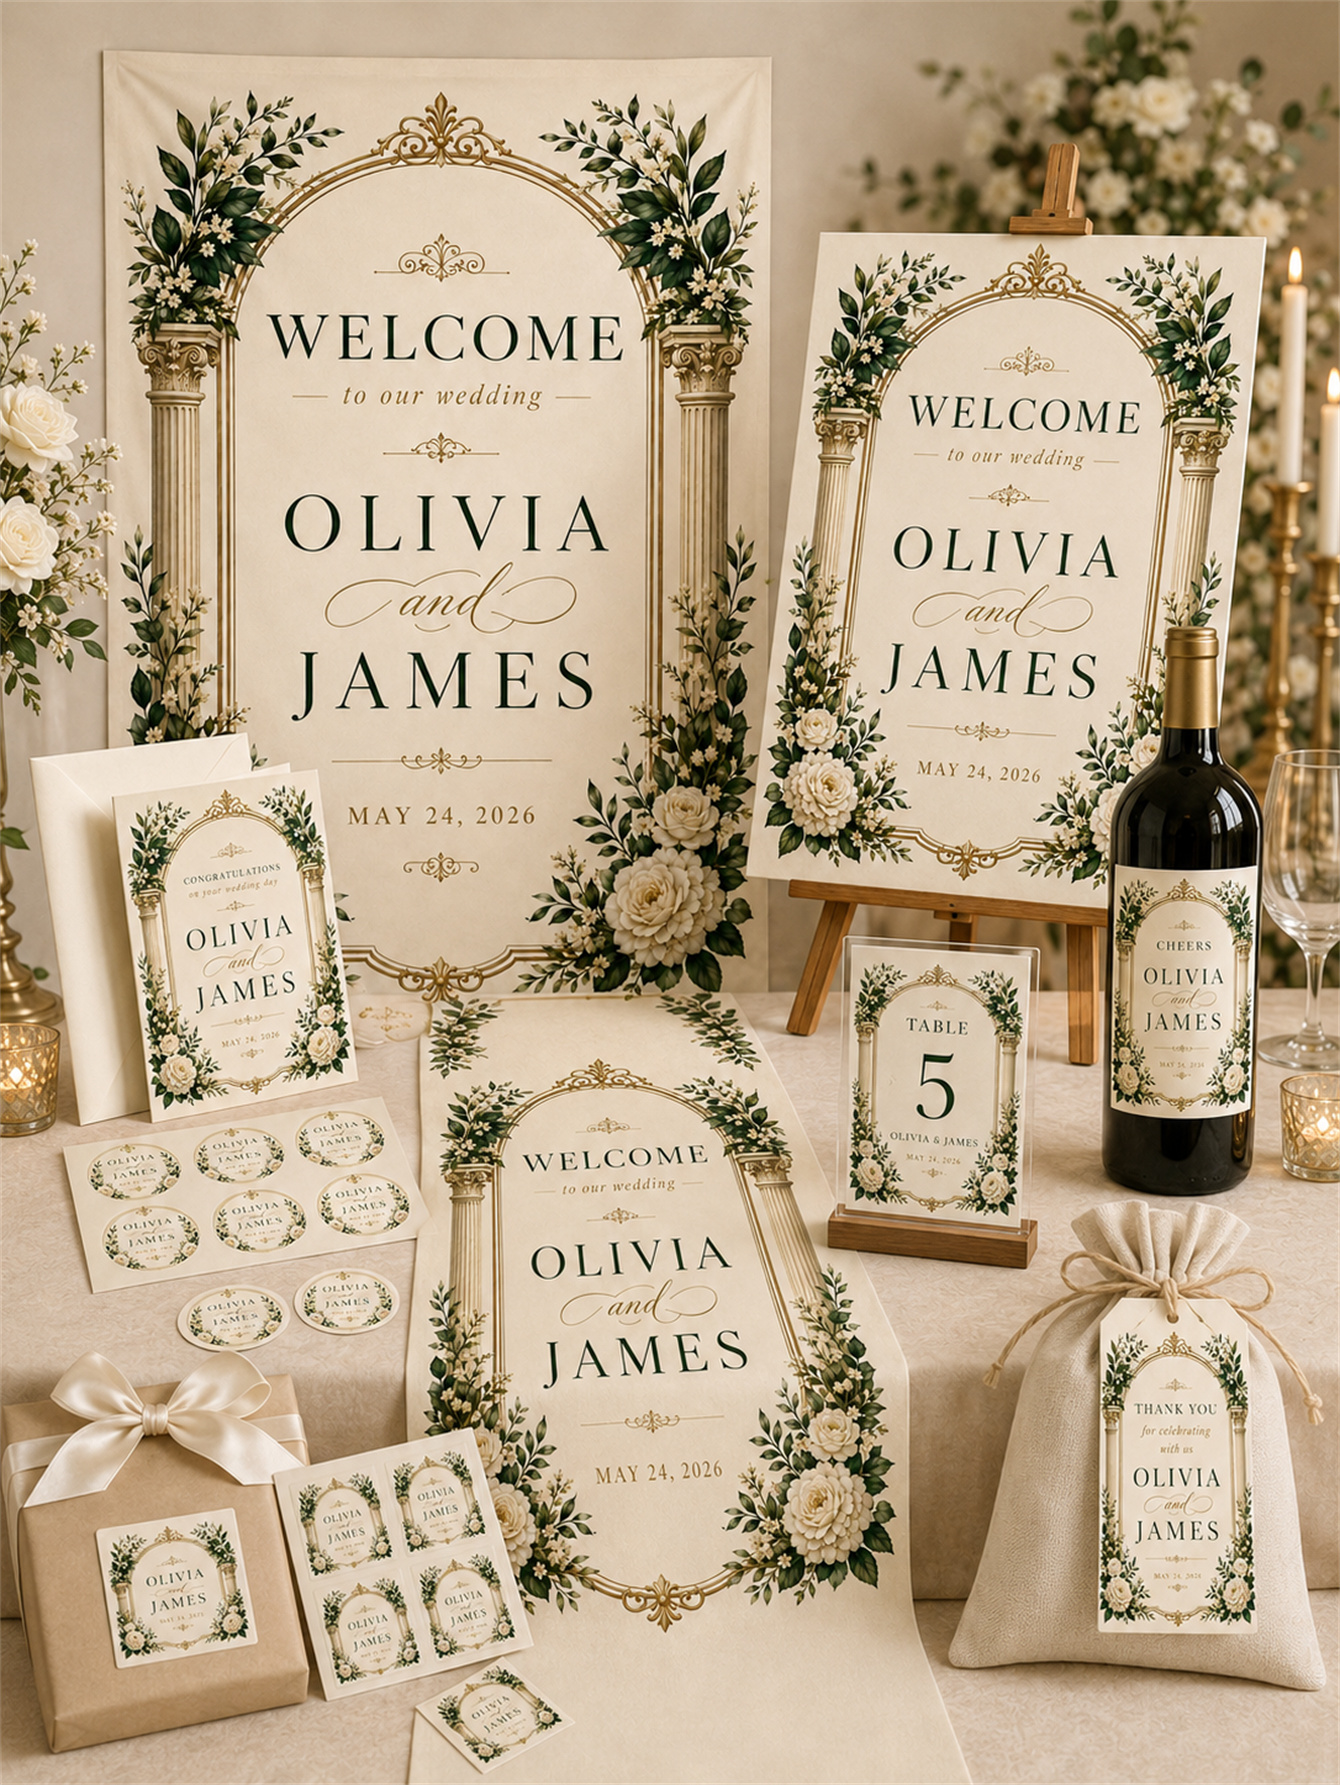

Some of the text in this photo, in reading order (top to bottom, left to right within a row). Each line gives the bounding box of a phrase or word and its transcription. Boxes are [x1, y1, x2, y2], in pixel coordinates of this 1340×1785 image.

[266, 314, 624, 361] WELCOME
[343, 384, 542, 411] to our wedding
[909, 395, 1141, 434] WELCOME
[947, 448, 1085, 471] to our wedding
[284, 494, 609, 552] OLIVIA
[893, 526, 1118, 578] OLIVIA
[399, 562, 577, 634] and
[964, 584, 1093, 638] and
[880, 643, 1097, 700] JAMES
[291, 651, 593, 721] JAMES
[917, 761, 1041, 783] MAY 24, 2026
[348, 805, 535, 827] MAY 24, 2026
[183, 863, 281, 886] CONGRATULATIONS
[225, 881, 261, 892] wedding
[263, 878, 278, 888] day
[186, 914, 293, 951] OLIVIA
[1156, 940, 1212, 951] CHEERS
[227, 943, 285, 972] and
[1144, 967, 1224, 985] OLIVIA
[195, 970, 296, 1014] JAMES
[1170, 988, 1217, 1010] and
[906, 1018, 968, 1035] TABLE
[1144, 1012, 1221, 1032] JAMES
[221, 1037, 241, 1048] MAY
[916, 1053, 955, 1120] 5
[313, 1120, 359, 1134] OLIVIA
[212, 1137, 258, 1151] OLIVIA
[319, 1134, 363, 1148] JAMES
[890, 1132, 979, 1147] OLIVIA & JAMES
[107, 1154, 154, 1166] OLIVIA
[218, 1151, 262, 1164] JAMES
[522, 1144, 708, 1173] WELCOME
[906, 1153, 924, 1161] MAY
[113, 1168, 157, 1181] JAMES
[335, 1185, 383, 1199] OLIVIA
[562, 1177, 676, 1195] to our wedding
[231, 1202, 280, 1216] OLIVIA
[341, 1200, 387, 1215] JAMES
[123, 1218, 172, 1231] OLIVIA
[237, 1217, 283, 1231] JAMES
[129, 1233, 176, 1248] JAMES
[531, 1236, 732, 1280] OLIVIA
[322, 1283, 369, 1293] OLIVIA
[206, 1298, 256, 1312] OLIVIA
[325, 1297, 370, 1309] JAMES
[607, 1279, 718, 1324] and
[212, 1313, 258, 1326] JAMES
[543, 1330, 749, 1389] JAMES
[1134, 1403, 1218, 1415] THANK YOU
[1140, 1424, 1211, 1439] for celebrating
[1160, 1443, 1180, 1453] with
[595, 1460, 723, 1485] MAY 24, 2026
[1133, 1467, 1220, 1487] OLIVIA
[417, 1486, 455, 1501] OLIVIA
[423, 1504, 458, 1521] JAMES
[1163, 1492, 1214, 1516] and
[323, 1509, 362, 1524] OLIVIA
[328, 1527, 365, 1545] JAMES
[1135, 1520, 1219, 1544] JAMES
[146, 1568, 205, 1588] OLIVIA
[150, 1592, 207, 1616] JAMES
[444, 1590, 483, 1606] OLIVIA
[347, 1614, 388, 1630] OLIVIA
[451, 1608, 487, 1628] JAMES
[353, 1633, 391, 1652] JAMES
